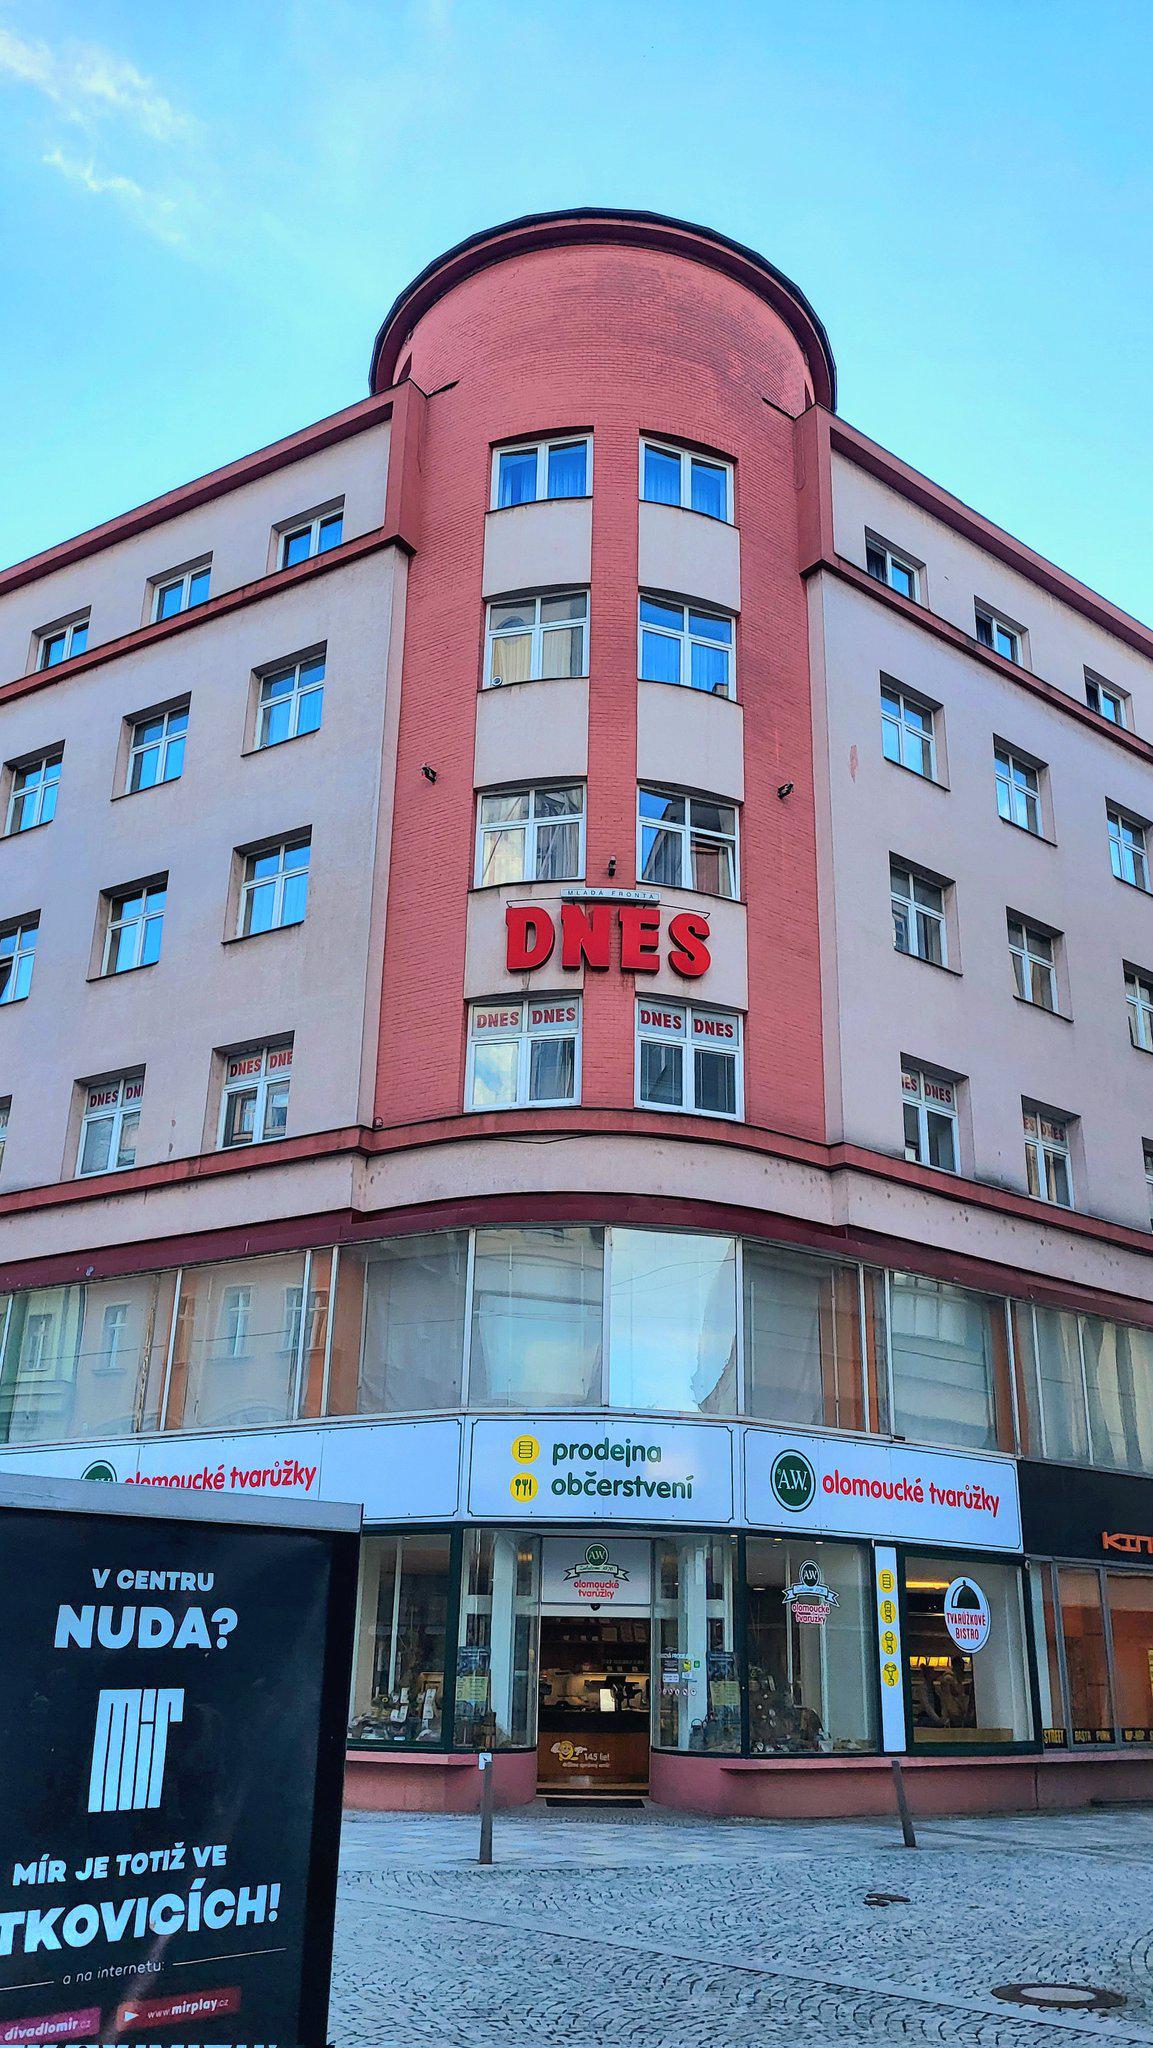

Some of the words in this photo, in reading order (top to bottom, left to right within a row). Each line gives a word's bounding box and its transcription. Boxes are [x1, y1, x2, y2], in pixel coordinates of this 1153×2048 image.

[611, 890, 655, 900] FRONTA
[505, 904, 711, 979] DNES
[476, 1011, 519, 1029] DNES
[532, 1007, 576, 1025] DNES
[640, 1009, 682, 1029] DNES
[693, 1018, 734, 1038] DNES
[229, 1058, 262, 1077] DNES
[89, 1089, 119, 1107] DNES
[126, 1084, 143, 1099] DN
[925, 1082, 952, 1103] DNES
[553, 1437, 662, 1467] prodejna
[230, 1459, 317, 1491] tvarůžky
[551, 1471, 694, 1500] občerstvení
[822, 1469, 924, 1503] olomoucké
[929, 1482, 1000, 1517] tvarůžky
[92, 1568, 111, 1589] V
[116, 1569, 215, 1592] CENTRU
[573, 1580, 620, 1589] olomoucké
[54, 1604, 239, 1650] NUDA?
[955, 1627, 980, 1641] BISTRO
[12, 1853, 67, 1887] MÍR
[75, 1856, 110, 1881] JE
[116, 1842, 187, 1877] TOTIŽ
[192, 1845, 228, 1868] VE
[63, 1974, 71, 1985] a
[76, 1971, 92, 1983] na
[97, 1960, 166, 1980] internetu:
